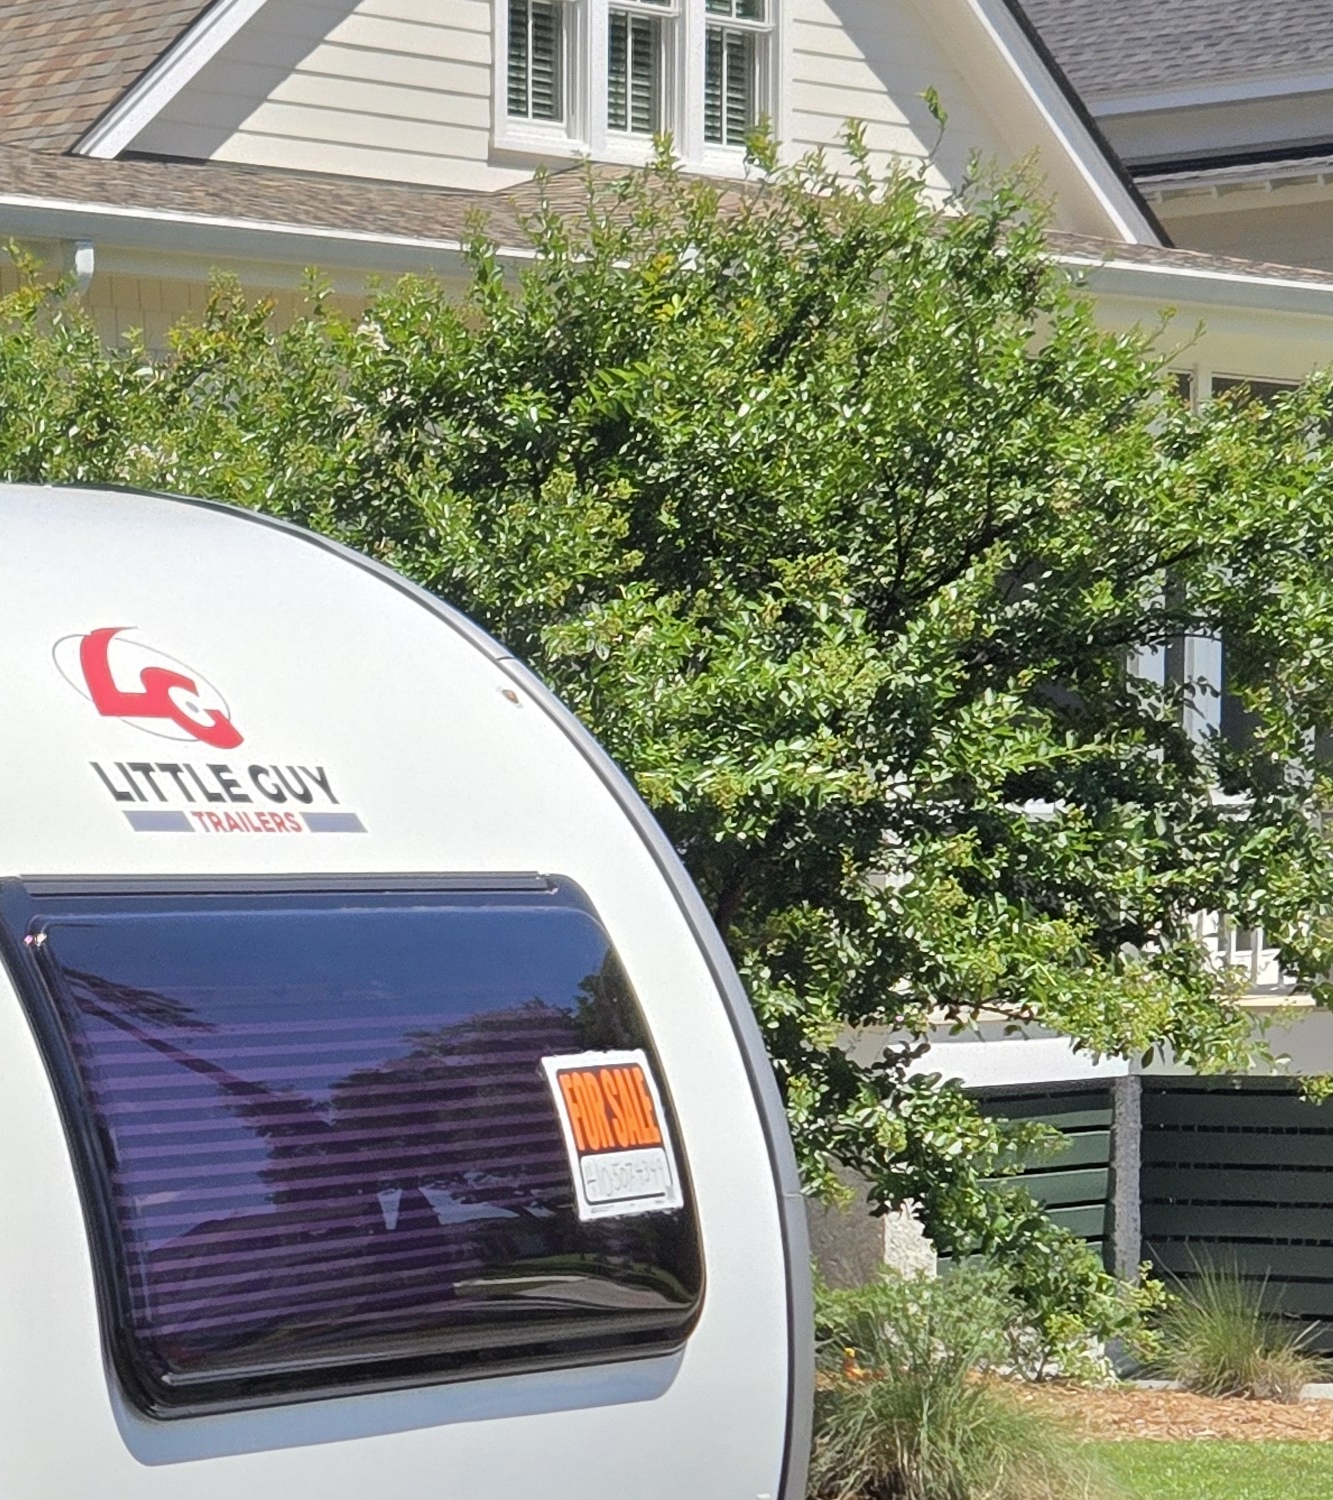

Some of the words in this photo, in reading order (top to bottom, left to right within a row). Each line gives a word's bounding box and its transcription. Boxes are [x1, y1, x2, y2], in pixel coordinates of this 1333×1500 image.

[89, 761, 254, 804] LITTLE
[247, 764, 341, 805] GUY
[190, 811, 303, 833] TRAILERS
[559, 1071, 616, 1151] FOR
[600, 1067, 662, 1148] SALE
